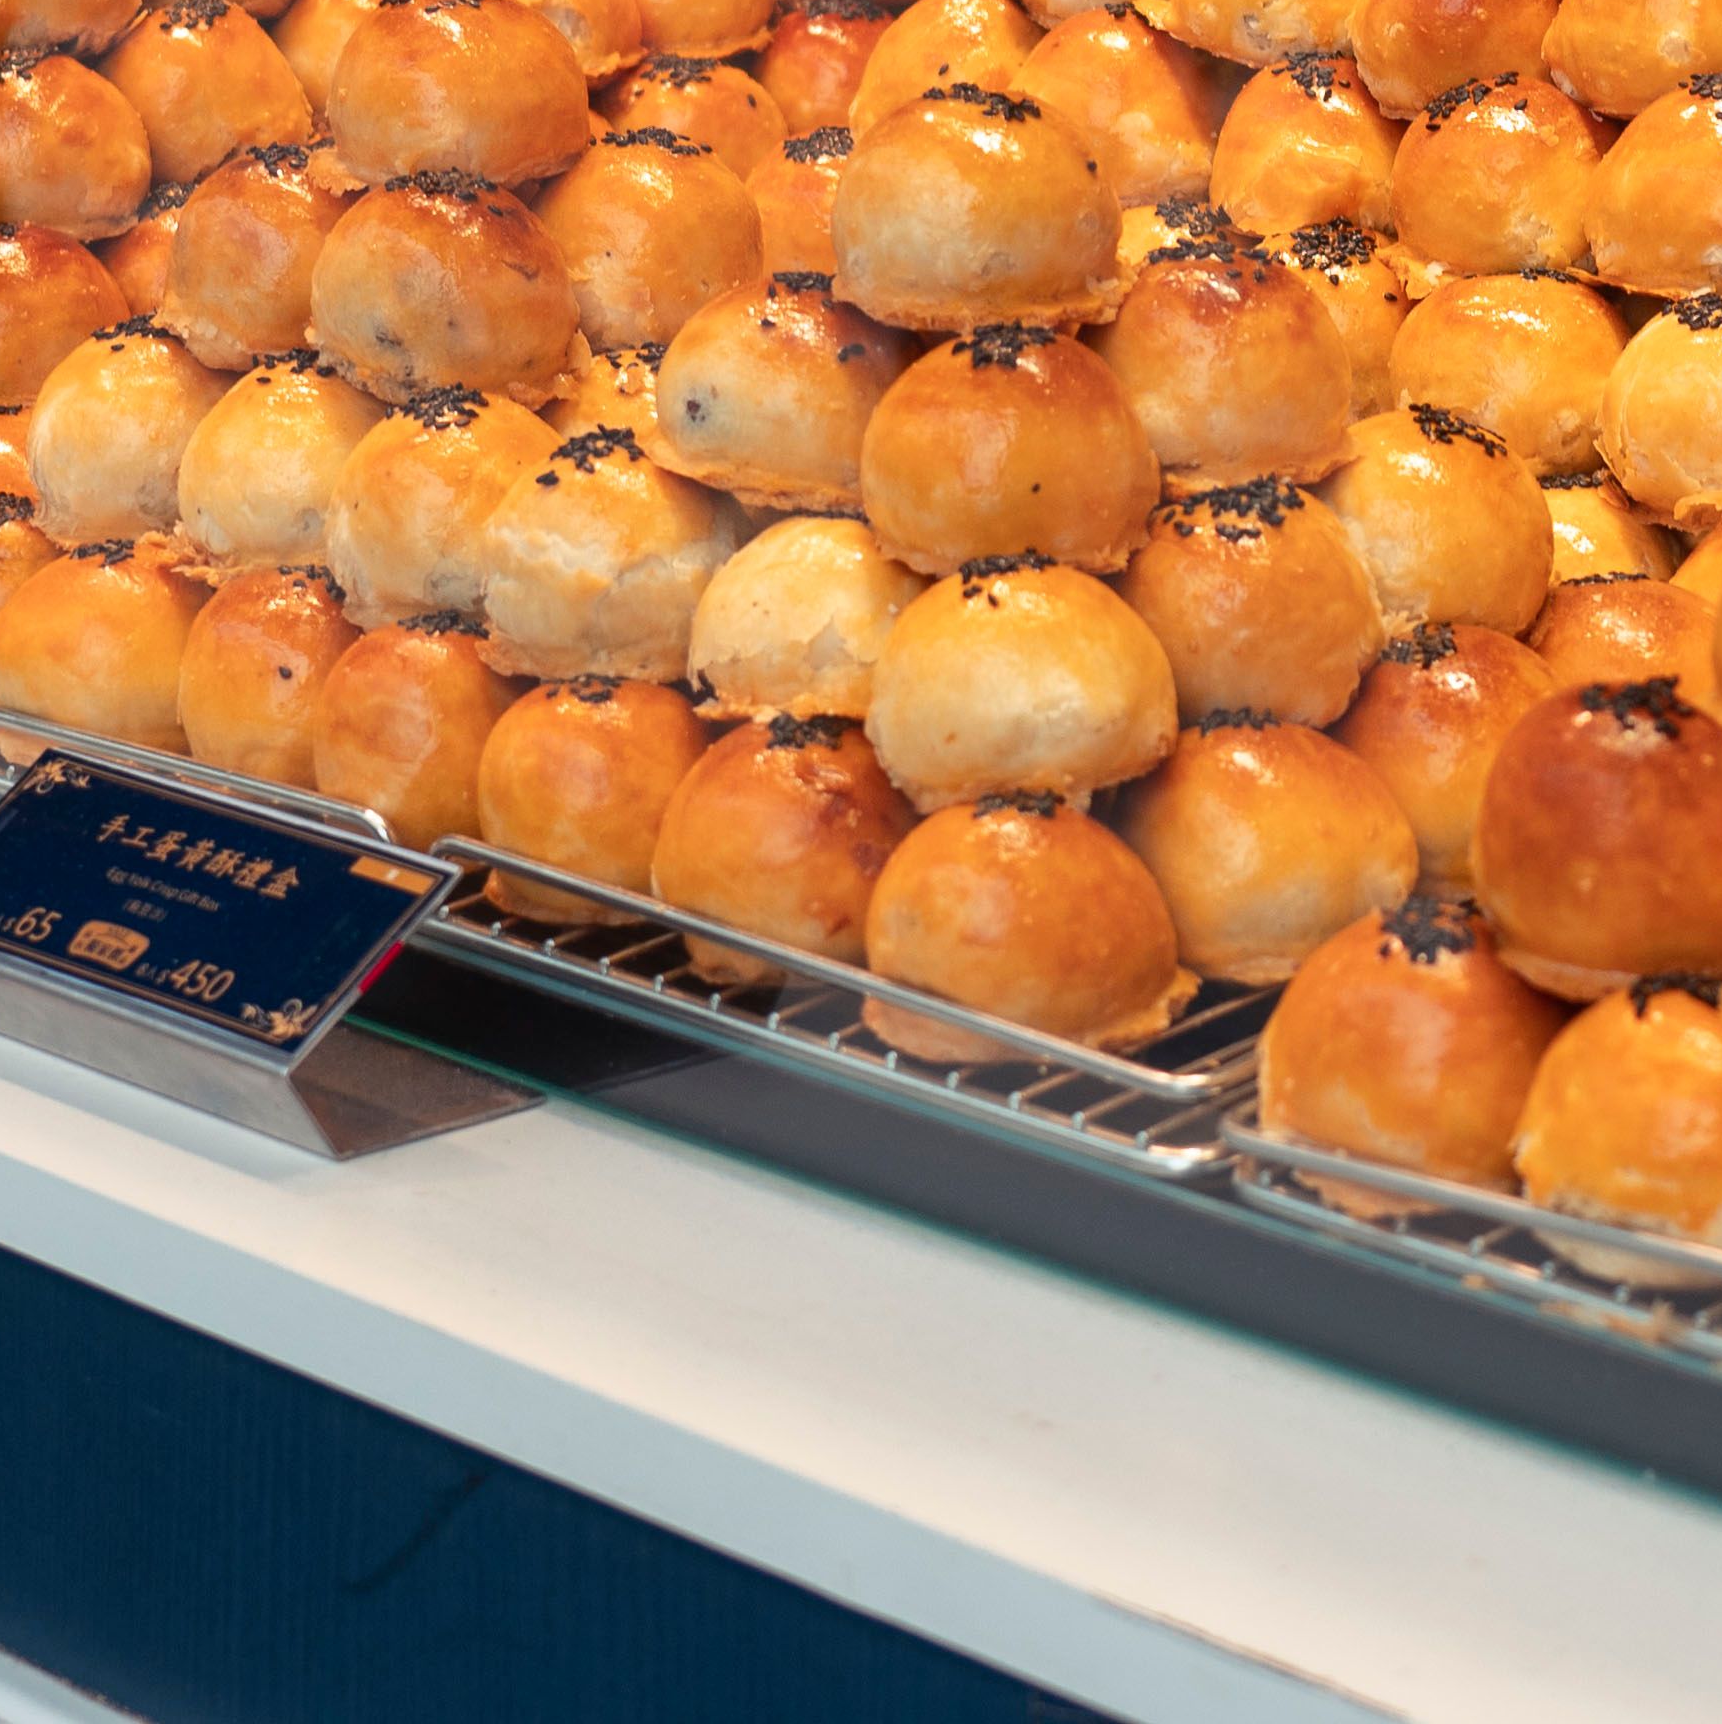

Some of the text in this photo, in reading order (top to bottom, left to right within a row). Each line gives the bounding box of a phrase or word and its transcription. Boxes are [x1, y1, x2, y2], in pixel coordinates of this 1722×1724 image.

[97, 814, 299, 899] 手工蛋黃酥禮盒
